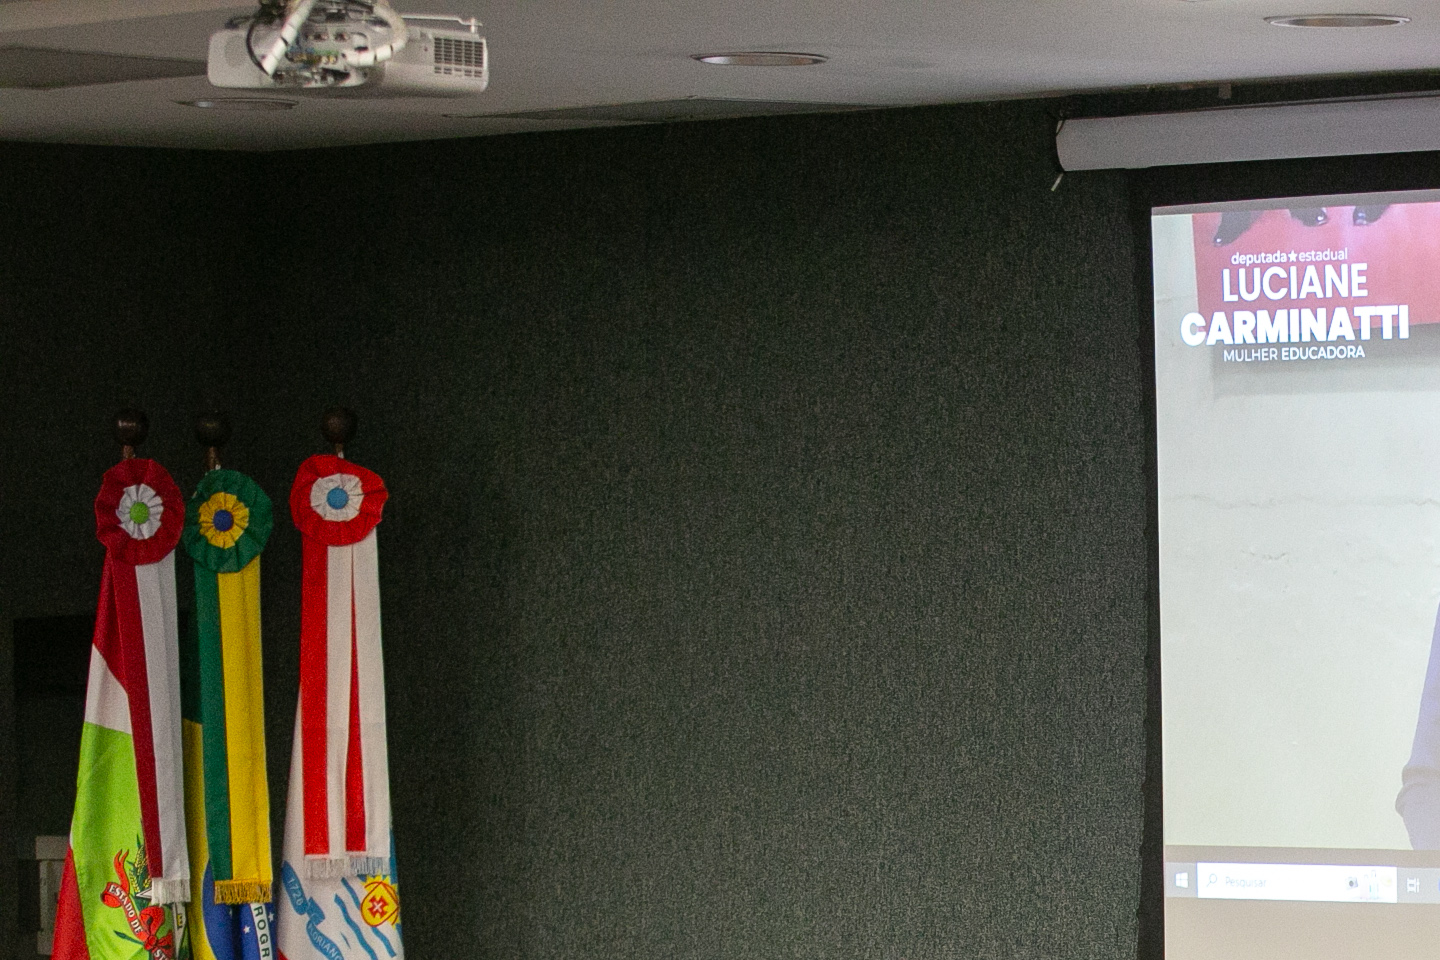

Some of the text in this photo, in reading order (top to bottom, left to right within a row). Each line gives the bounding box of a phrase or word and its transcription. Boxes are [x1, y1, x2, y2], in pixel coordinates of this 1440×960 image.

[1231, 248, 1348, 266] deputada estadual
[1222, 263, 1368, 302] LUCIANE
[1180, 305, 1410, 347] CARMINATTI
[1223, 345, 1365, 362] MULHER EDUCADORA
[1225, 876, 1267, 889] Pesquisar
[108, 884, 143, 934] ESTADO DE
